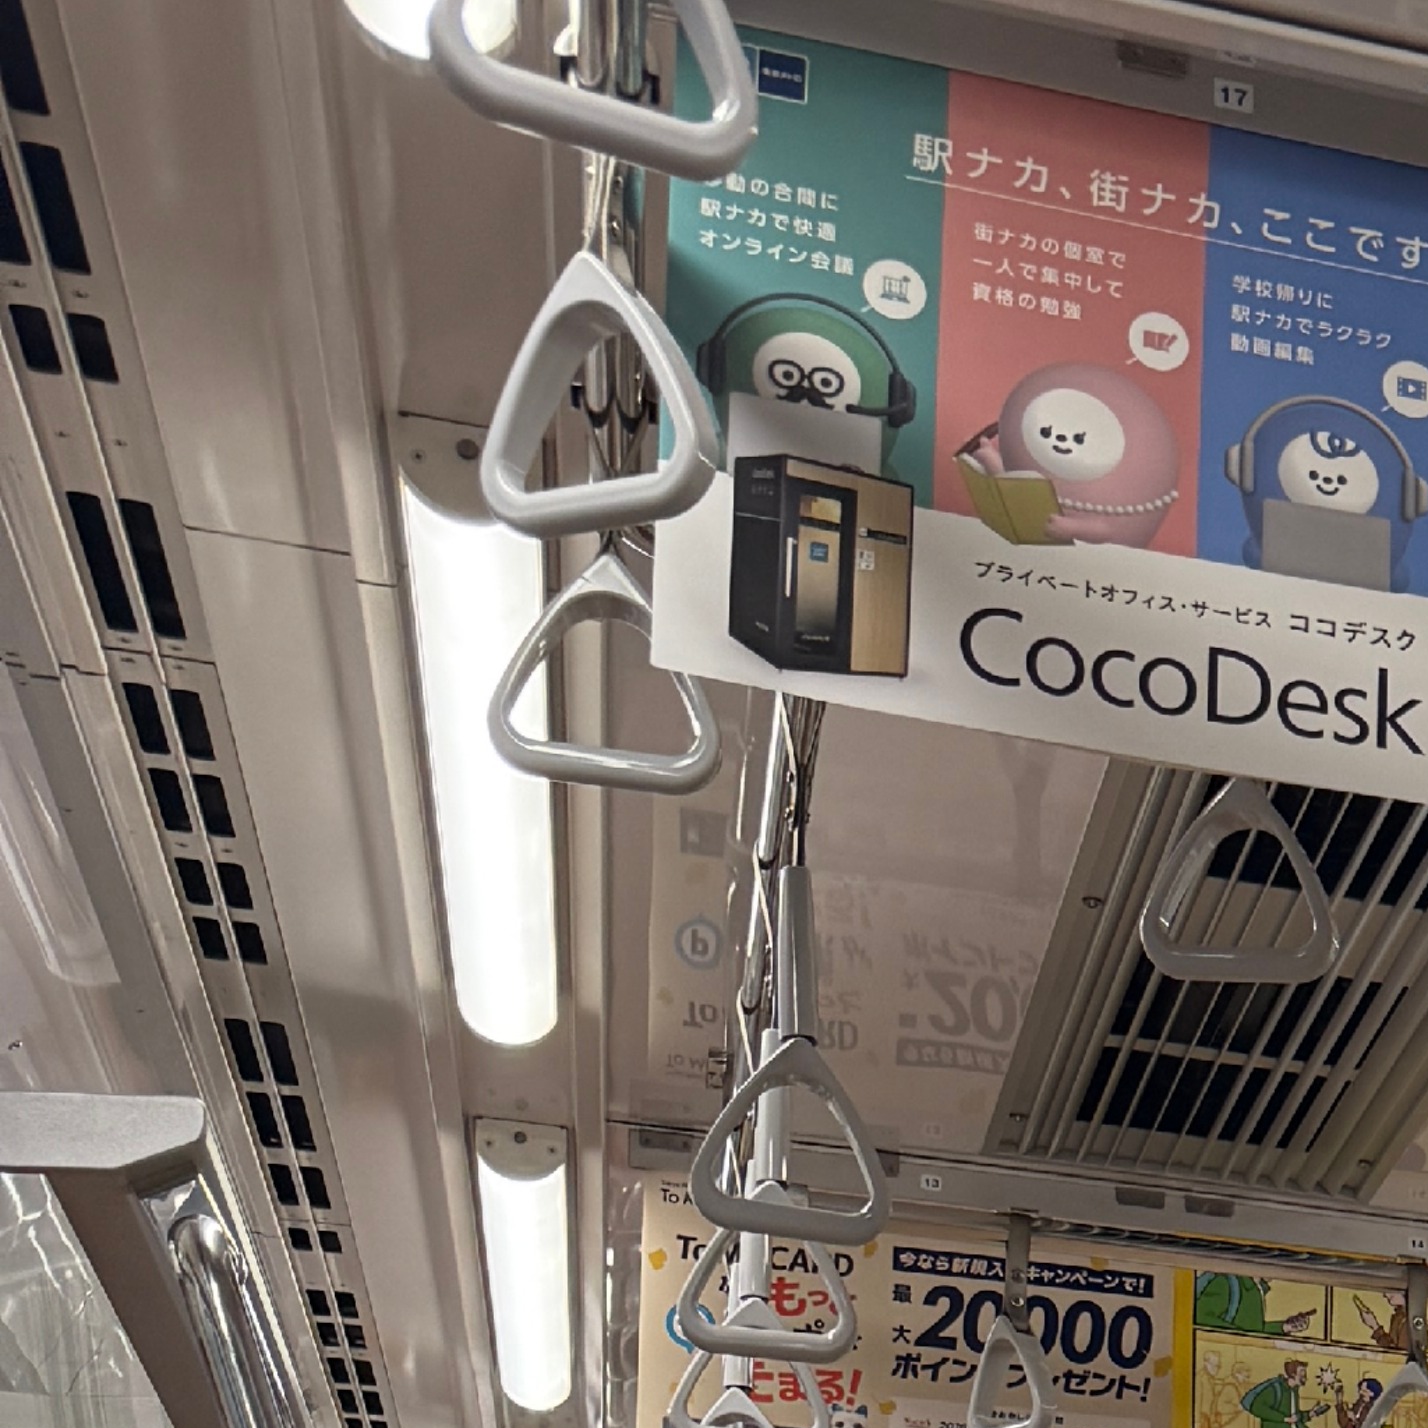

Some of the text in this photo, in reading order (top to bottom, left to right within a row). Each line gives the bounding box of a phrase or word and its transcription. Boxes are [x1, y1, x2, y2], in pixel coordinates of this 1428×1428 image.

[1219, 85, 1248, 107] 17
[704, 170, 840, 212] 動の合間に
[699, 197, 837, 243] 駅ナカで快適
[699, 229, 855, 277] オンライン会議
[973, 222, 1127, 269] 街ナカの個室で
[972, 256, 1125, 299] 一人で集中して
[1231, 274, 1334, 311] 学校帰りに
[972, 281, 1082, 321] 資格の勉強
[1230, 304, 1392, 351] 駅ナカでラクラク
[1230, 332, 1316, 367] 動画編集
[974, 560, 1418, 652] プライベートオフィス・サービス ココデスク
[959, 606, 1426, 757] CocoDesk
[899, 1249, 1147, 1296] 今なら新規入キャンペーンで!
